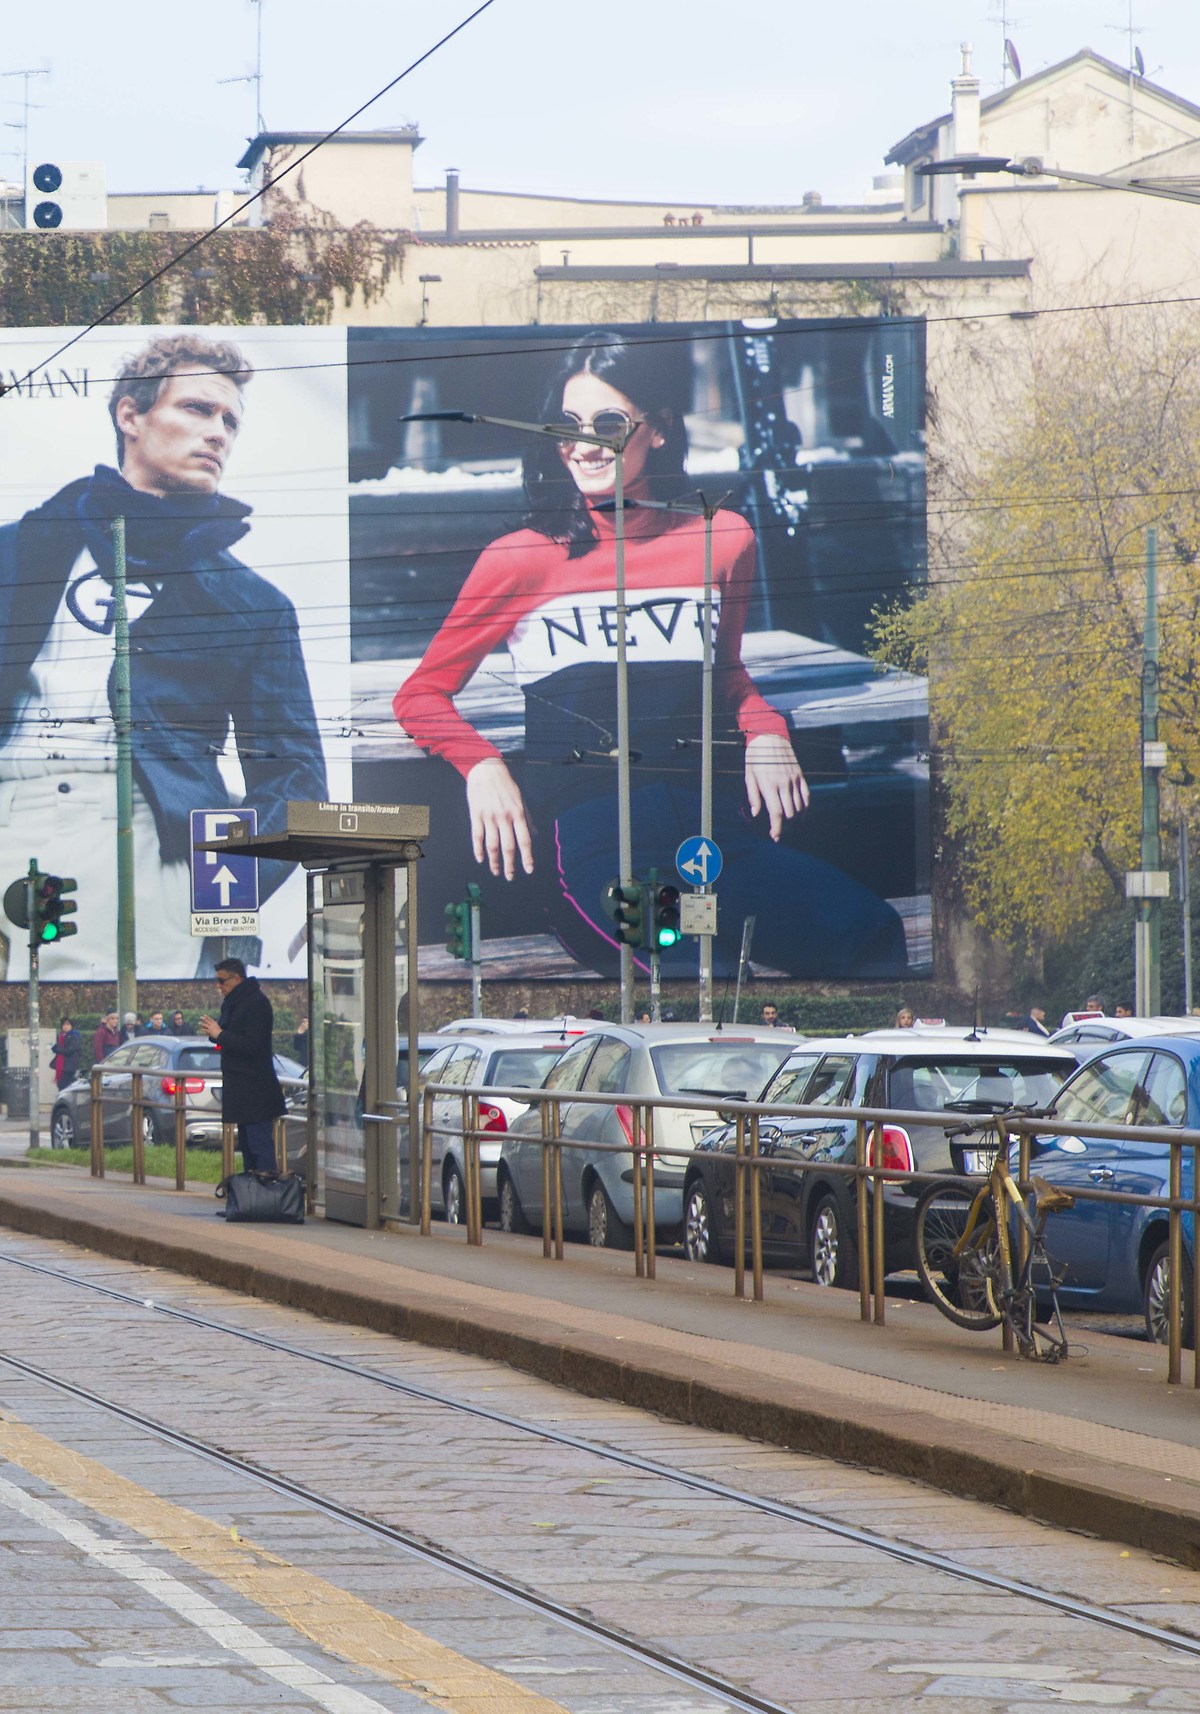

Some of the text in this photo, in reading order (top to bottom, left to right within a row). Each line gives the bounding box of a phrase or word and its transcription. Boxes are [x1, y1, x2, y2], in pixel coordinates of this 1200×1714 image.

[340, 803, 347, 812] in
[195, 915, 256, 925] Via Brera 3/a
